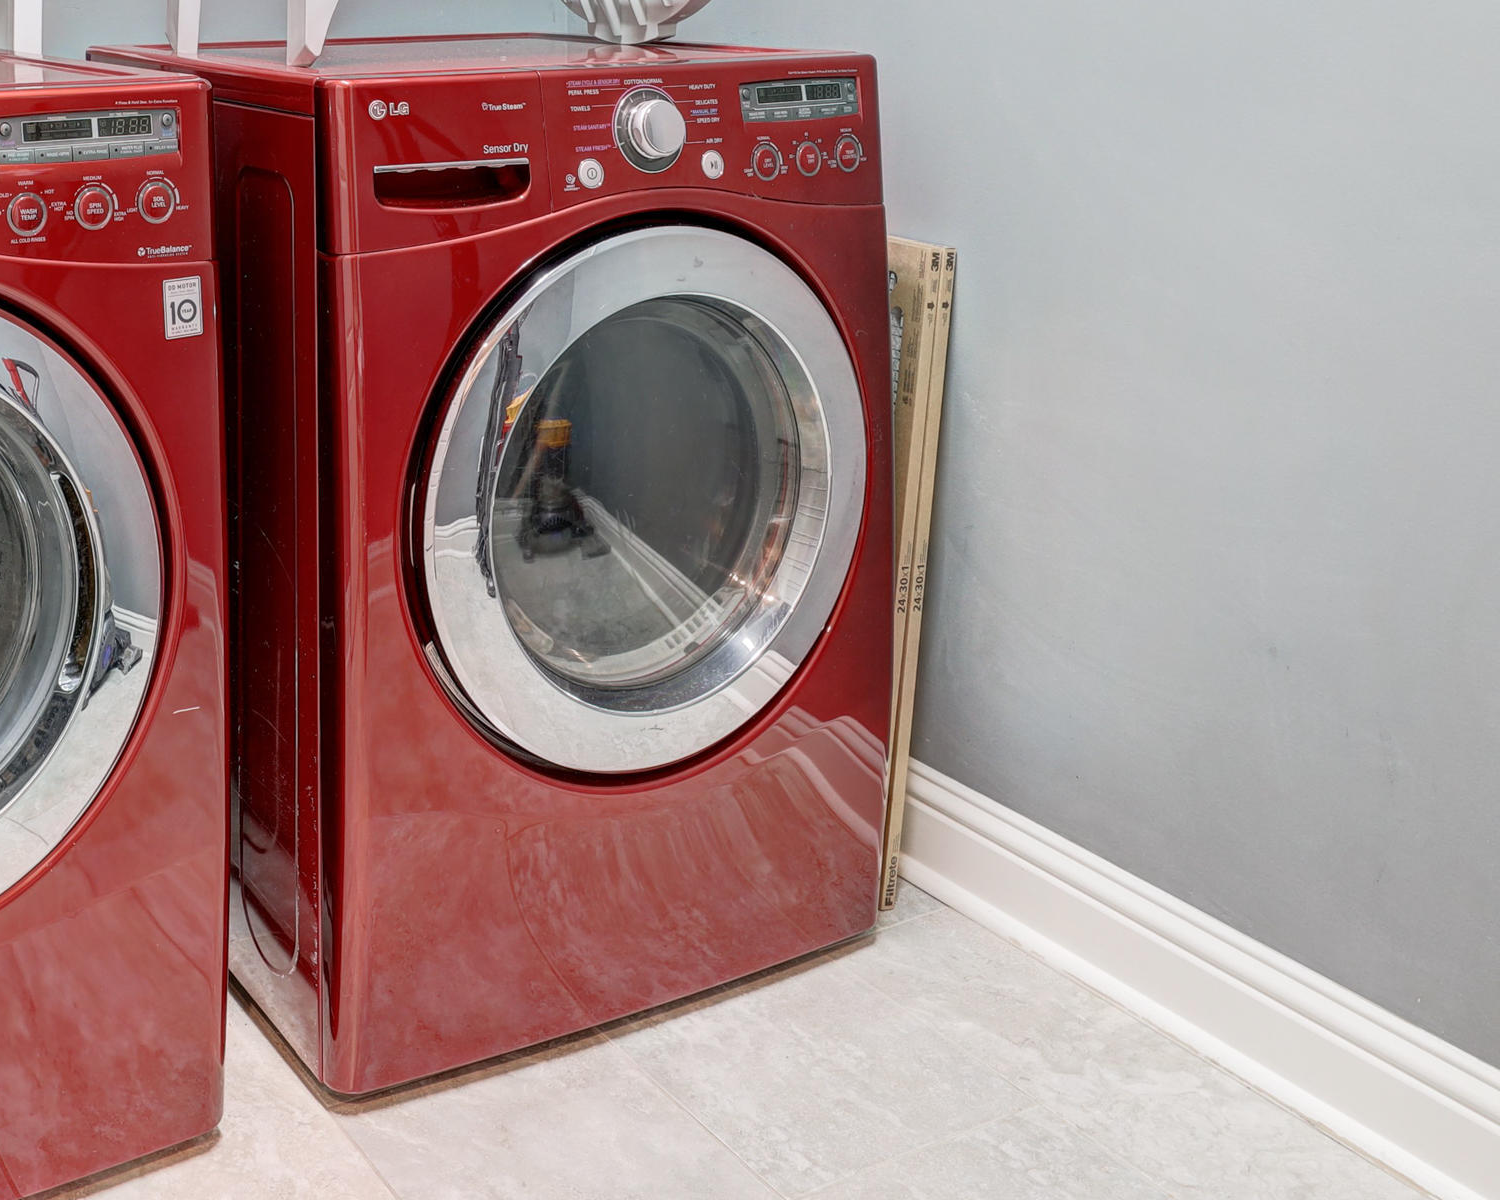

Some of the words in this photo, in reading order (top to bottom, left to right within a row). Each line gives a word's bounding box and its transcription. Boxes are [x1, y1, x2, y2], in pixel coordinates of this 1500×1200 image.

[389, 102, 410, 116] LG
[483, 143, 512, 154] Sensor
[513, 142, 529, 153] Dry
[931, 252, 940, 272] 3M
[946, 252, 955, 271] 3M
[177, 282, 196, 290] MOTOR
[170, 299, 197, 325] 10
[885, 856, 898, 906] Filtrete
